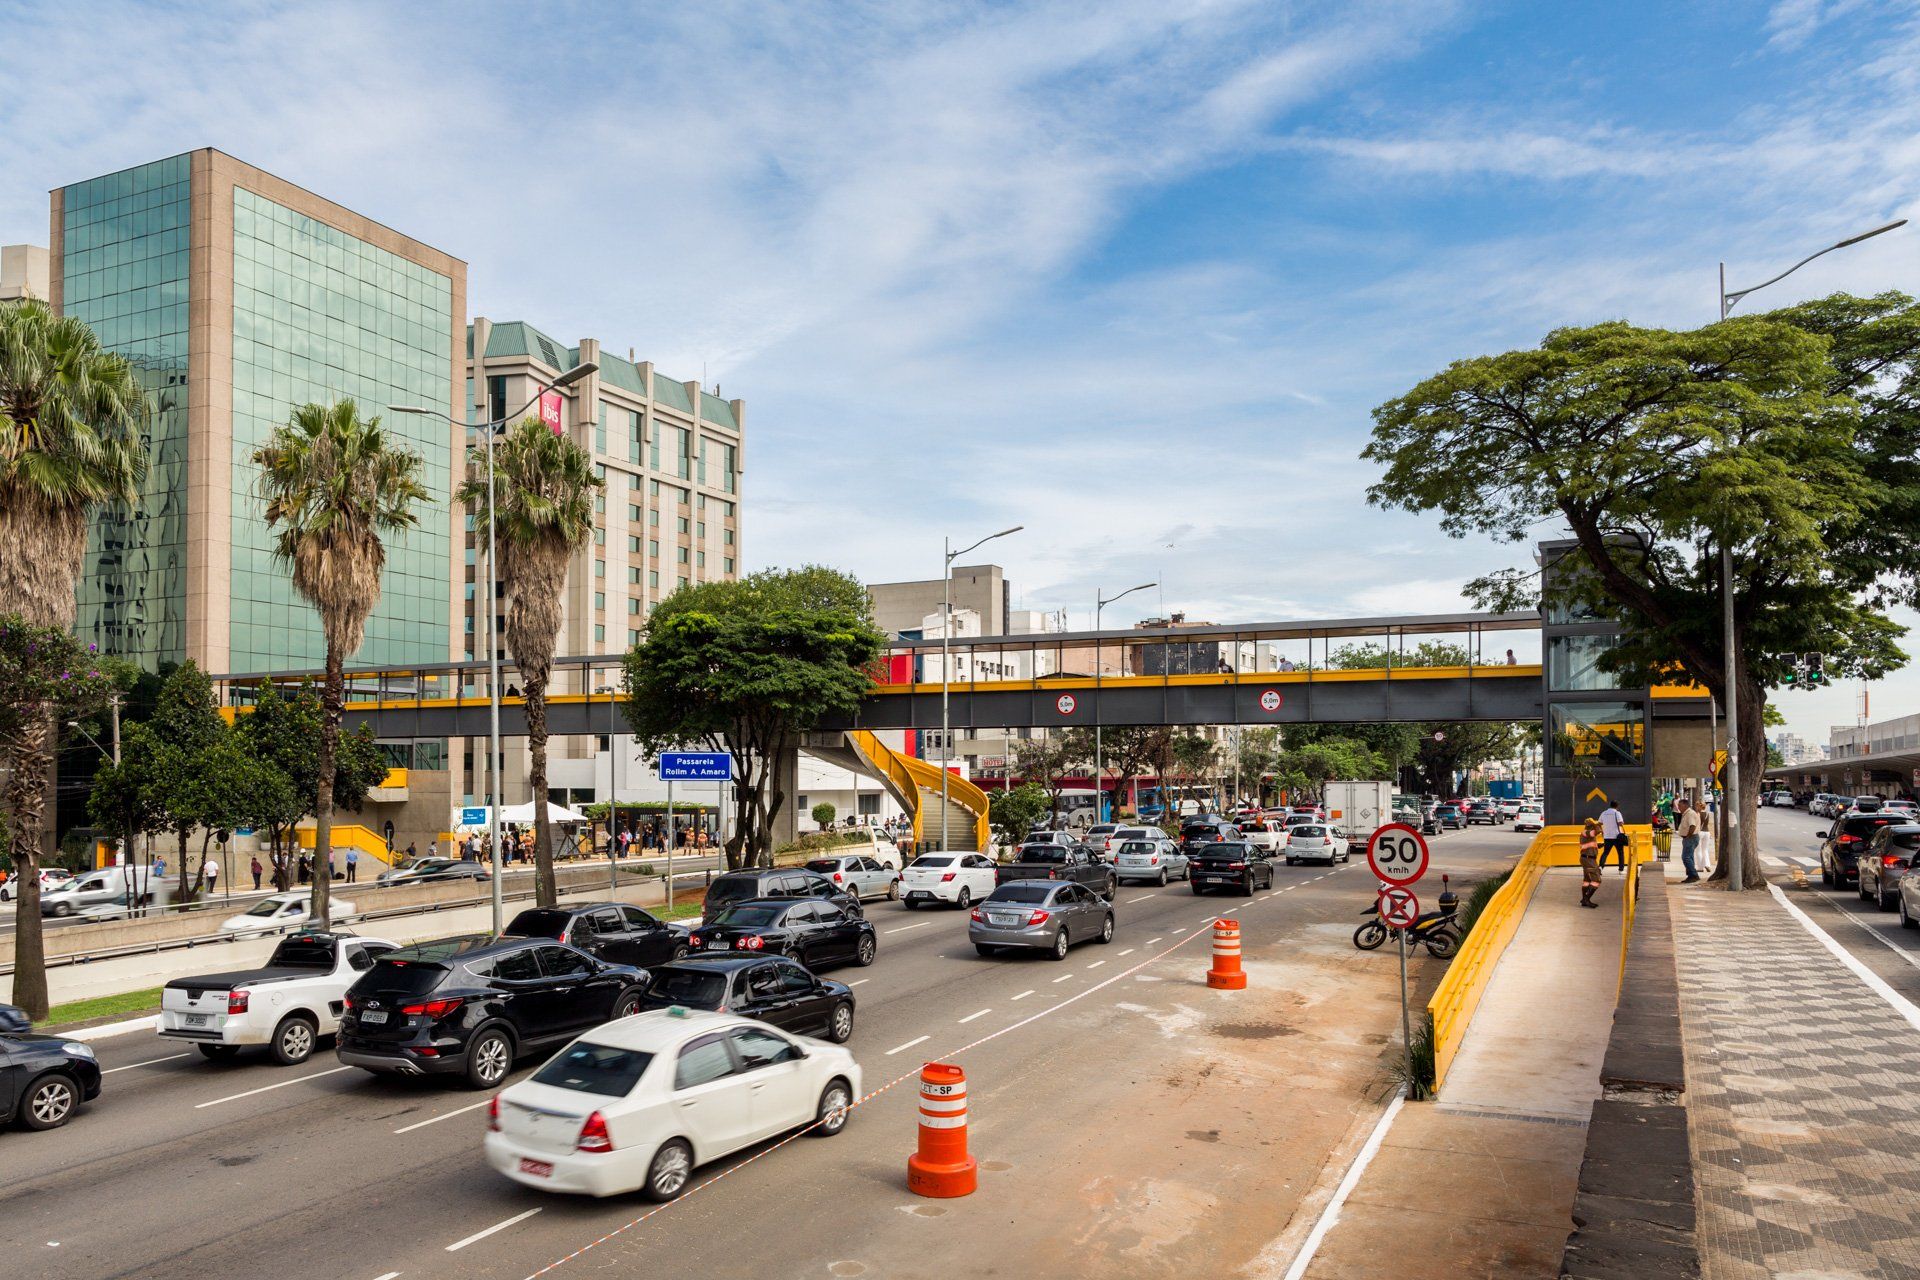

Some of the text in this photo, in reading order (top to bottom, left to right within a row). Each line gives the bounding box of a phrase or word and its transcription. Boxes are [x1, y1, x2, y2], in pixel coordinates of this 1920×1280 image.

[544, 402, 559, 424] ibis
[676, 757, 714, 765] Passarela
[1379, 836, 1417, 863] 50
[1388, 866, 1409, 874] km/h
[940, 1086, 952, 1094] SP
